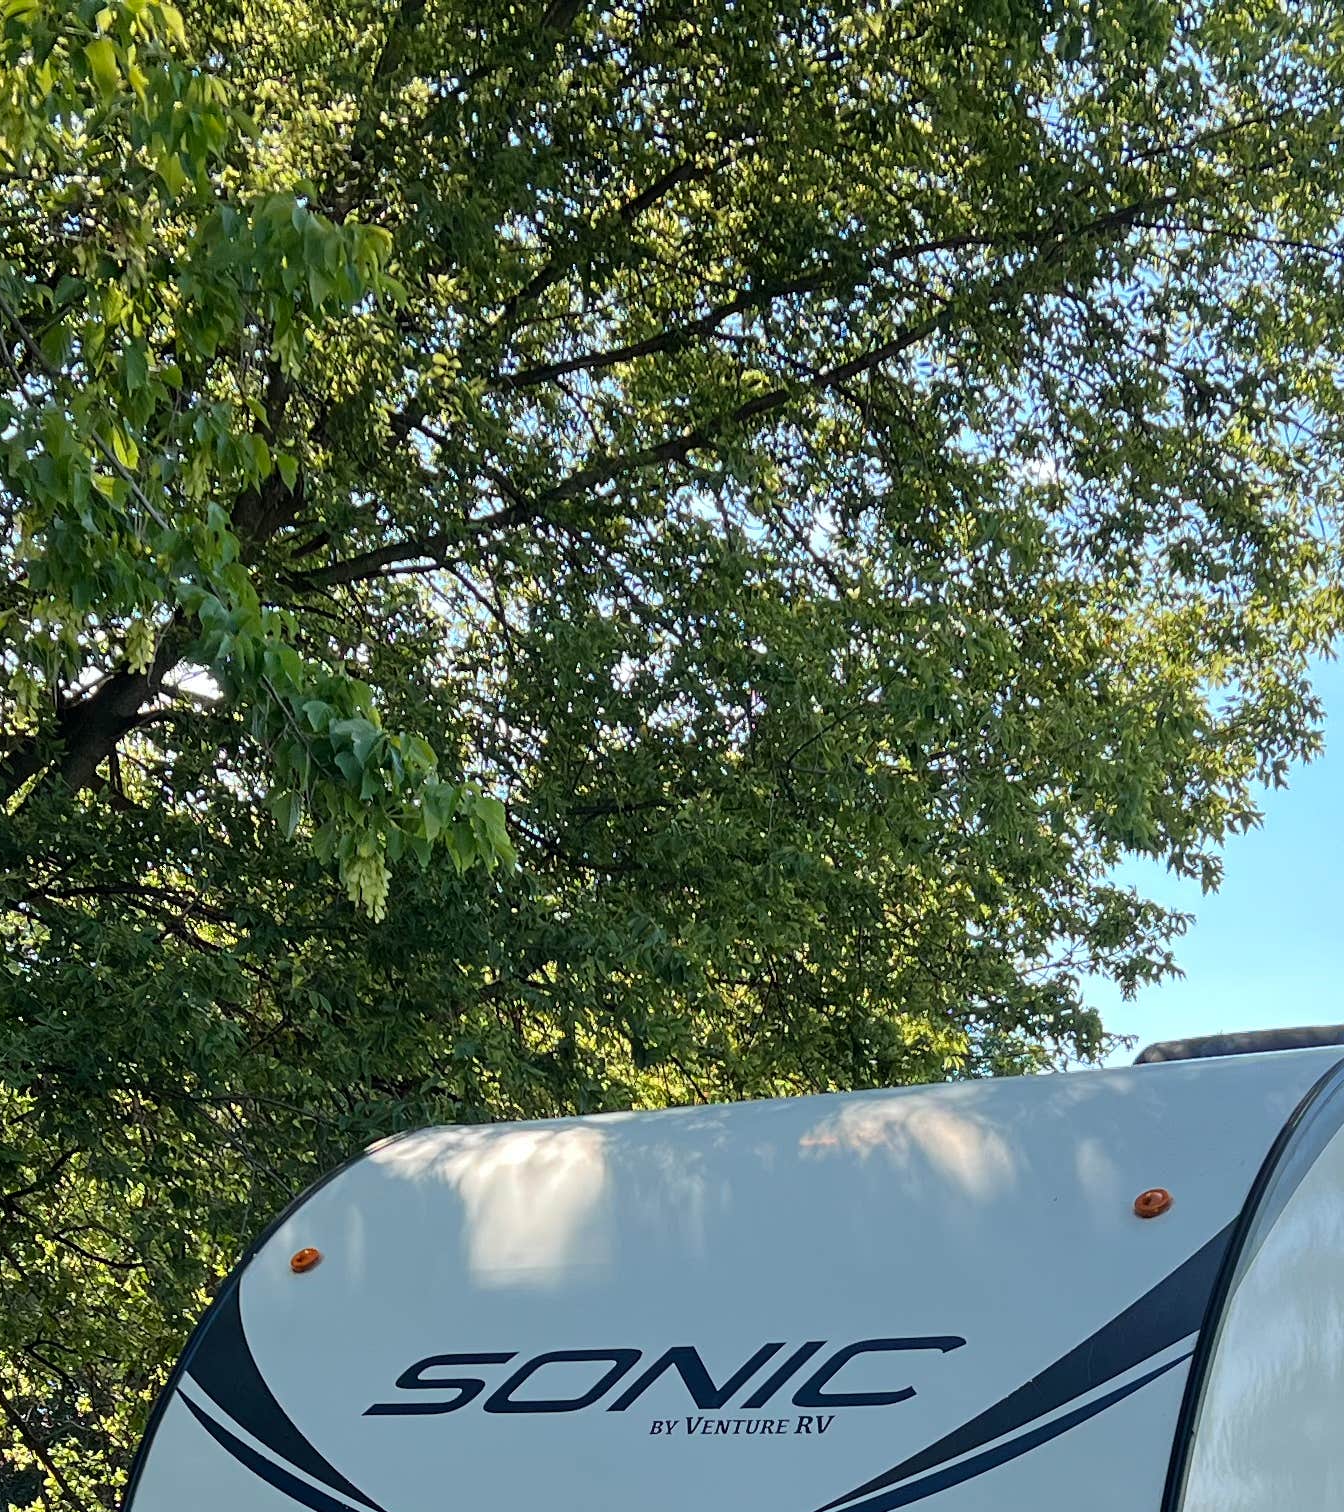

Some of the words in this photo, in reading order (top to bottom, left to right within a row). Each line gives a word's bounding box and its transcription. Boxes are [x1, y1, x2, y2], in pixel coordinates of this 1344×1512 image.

[362, 1336, 966, 1416] SONIC
[649, 1420, 679, 1435] BY
[686, 1416, 789, 1435] VENTURE
[794, 1415, 836, 1434] RV
